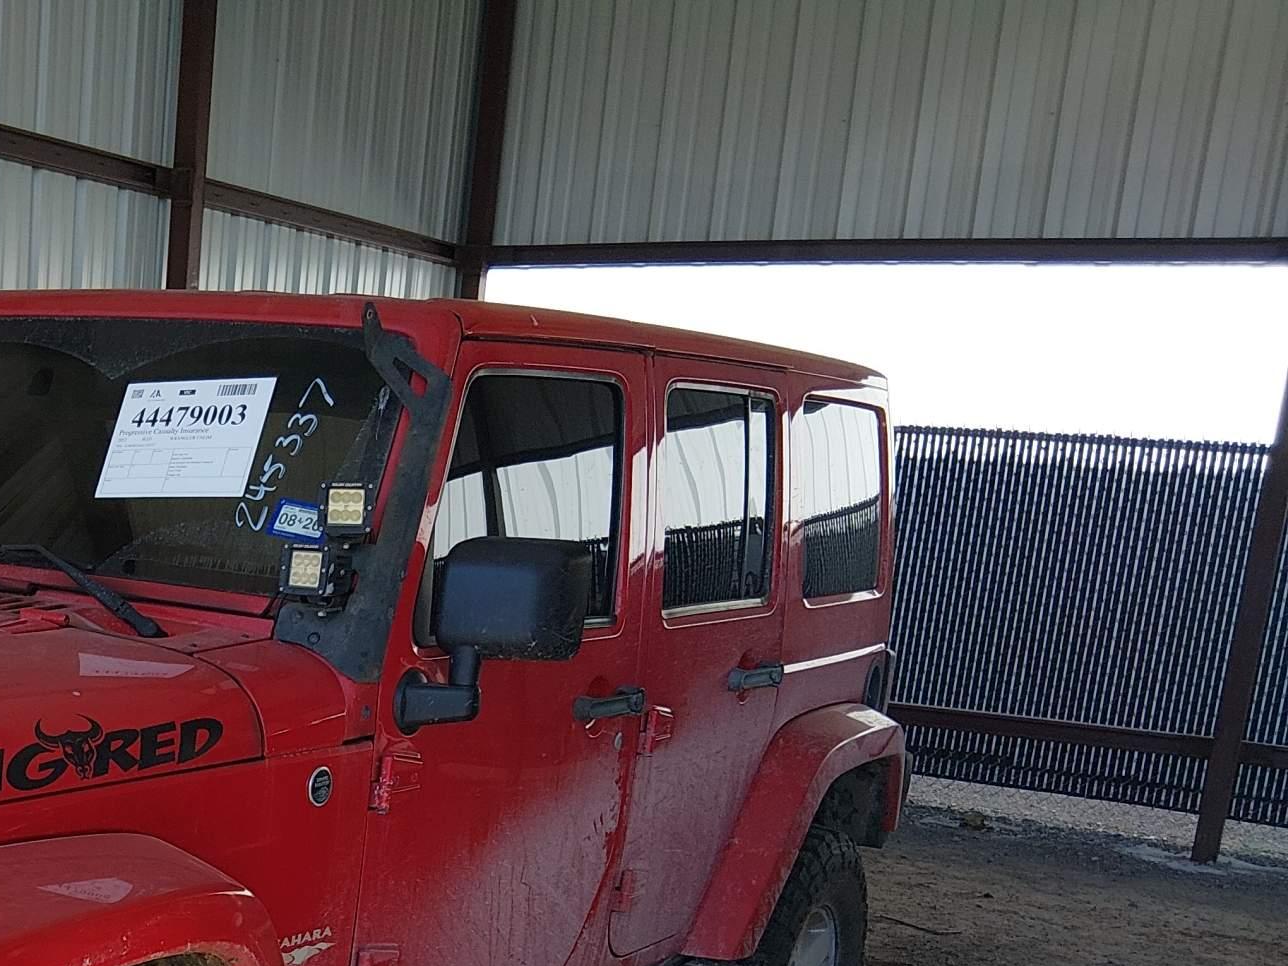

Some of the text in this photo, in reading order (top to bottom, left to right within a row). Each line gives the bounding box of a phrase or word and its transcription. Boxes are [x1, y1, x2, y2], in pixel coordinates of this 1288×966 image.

[130, 404, 248, 428] 44479003
[278, 512, 298, 527] 08
[91, 718, 224, 778] RED
[278, 926, 332, 949] AHARA
